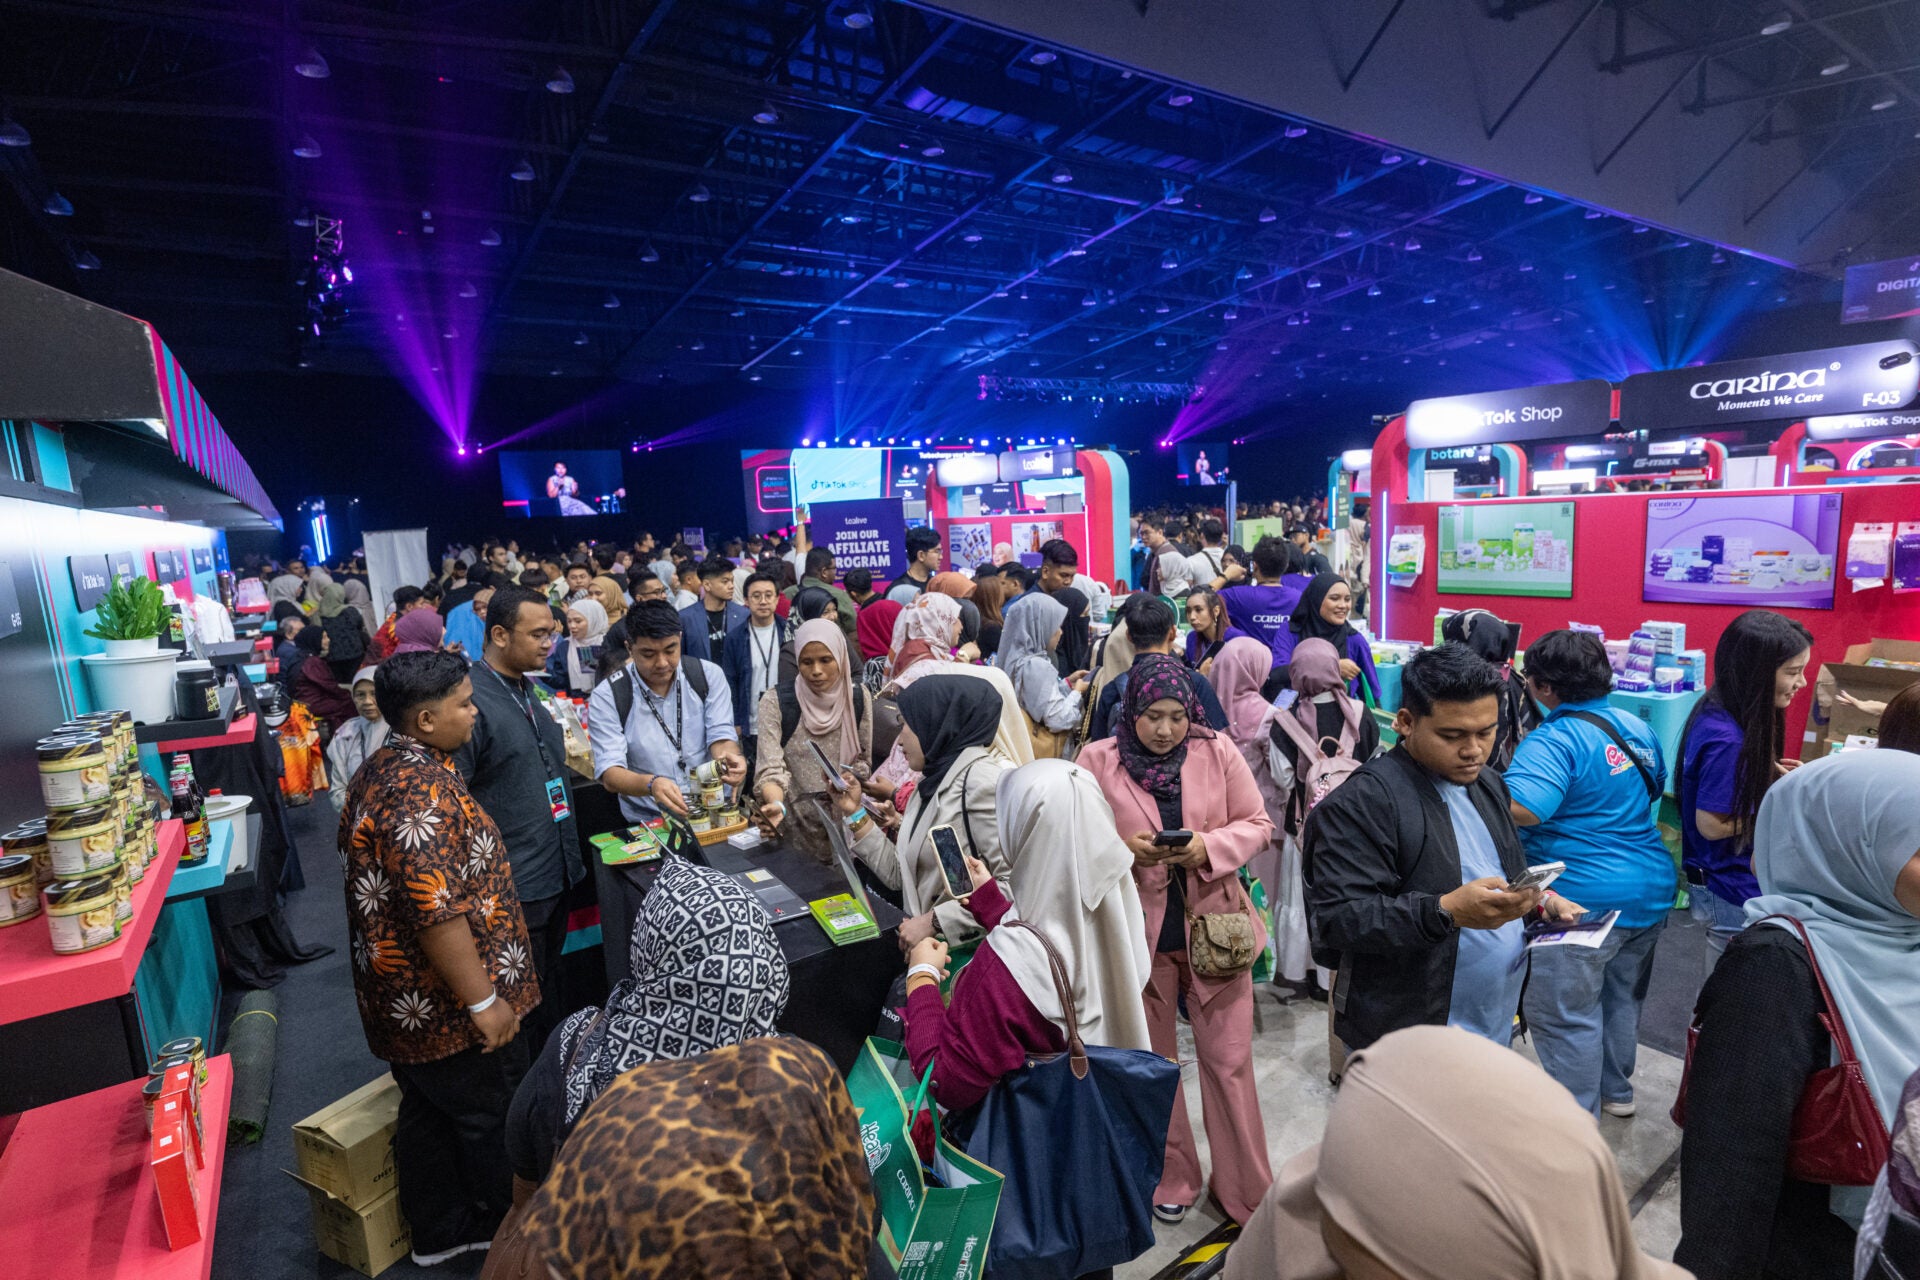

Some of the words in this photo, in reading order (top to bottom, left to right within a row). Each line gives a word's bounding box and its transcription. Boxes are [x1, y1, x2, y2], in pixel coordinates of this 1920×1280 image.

[1717, 398, 1771, 411] Moments
[1773, 394, 1792, 405] We
[1794, 392, 1824, 403] Care
[1862, 390, 1900, 406] F-03
[1520, 406, 1562, 422] Shop
[1891, 415, 1920, 426] Shop
[844, 516, 868, 525] tealive
[835, 531, 858, 541] JOIN
[859, 529, 879, 539] OUR
[827, 540, 890, 555] AFFILIATE
[834, 554, 891, 569] ROGRAM
[1252, 613, 1291, 624] carin
